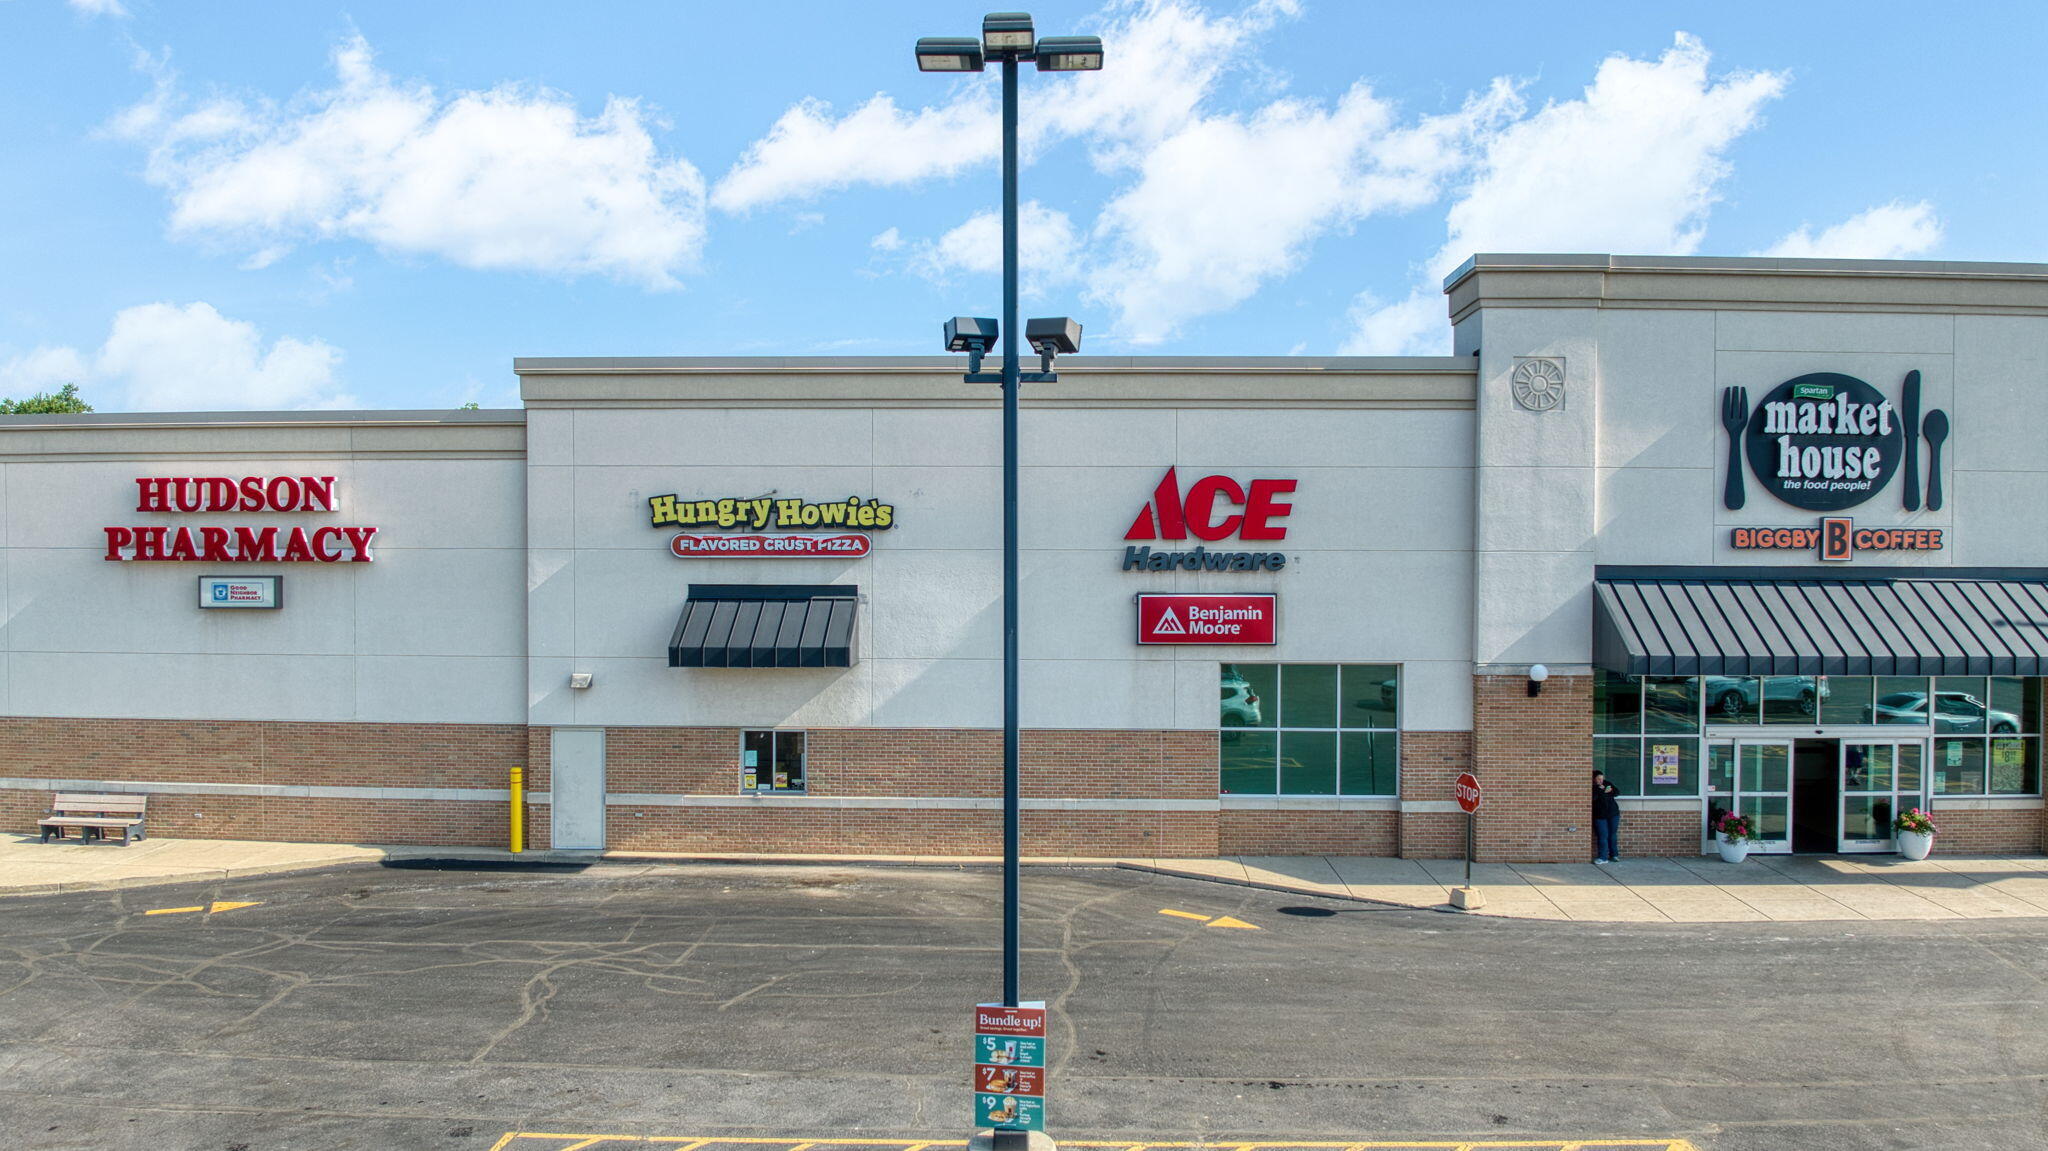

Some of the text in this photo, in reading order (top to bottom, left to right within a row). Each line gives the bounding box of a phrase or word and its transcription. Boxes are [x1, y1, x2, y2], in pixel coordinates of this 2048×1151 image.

[1799, 386, 1828, 396] Spartan
[1764, 392, 1892, 436] market
[1777, 435, 1881, 480] house
[136, 476, 338, 512] HUDSON
[1783, 480, 1872, 492] the food people!
[649, 494, 894, 530] Hungry Howie's
[1124, 465, 1297, 541] ACE
[104, 527, 379, 562] PHARMACY
[680, 539, 863, 551] FLAVORED CRUST PIZZA
[1732, 522, 1943, 556] BIGGBY B COFFEE
[1123, 546, 1286, 571] Hardware
[1189, 605, 1263, 622] Benjamin
[1189, 621, 1241, 635] Moore
[1457, 784, 1478, 803] STOP
[980, 1013, 1021, 1026] Bundle
[1023, 1016, 1042, 1030] up!
[983, 1037, 996, 1050] $5
[982, 1067, 996, 1081] $7
[982, 1096, 997, 1110] $9
